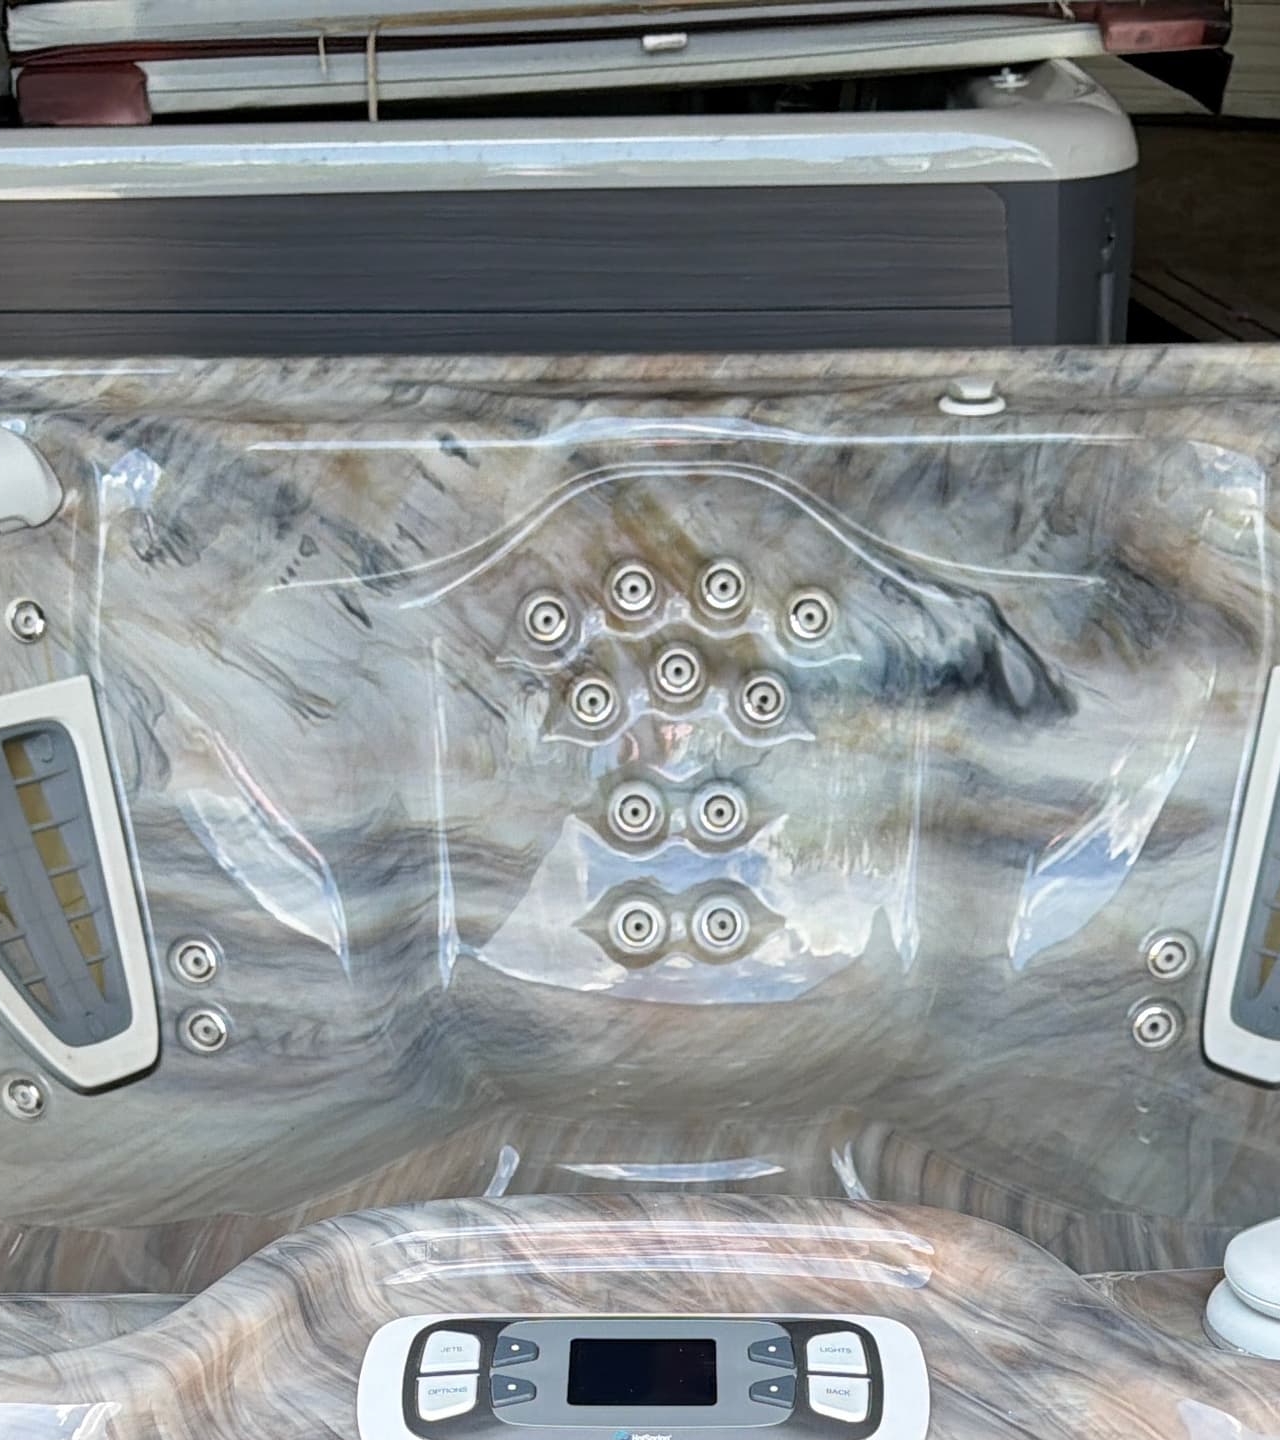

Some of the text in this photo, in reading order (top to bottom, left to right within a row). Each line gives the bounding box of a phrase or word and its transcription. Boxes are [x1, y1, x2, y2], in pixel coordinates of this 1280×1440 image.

[440, 1345, 463, 1353] JETS
[819, 1346, 852, 1354] LIGHTS
[428, 1386, 468, 1395] OPTIONS
[826, 1388, 850, 1397] BACK
